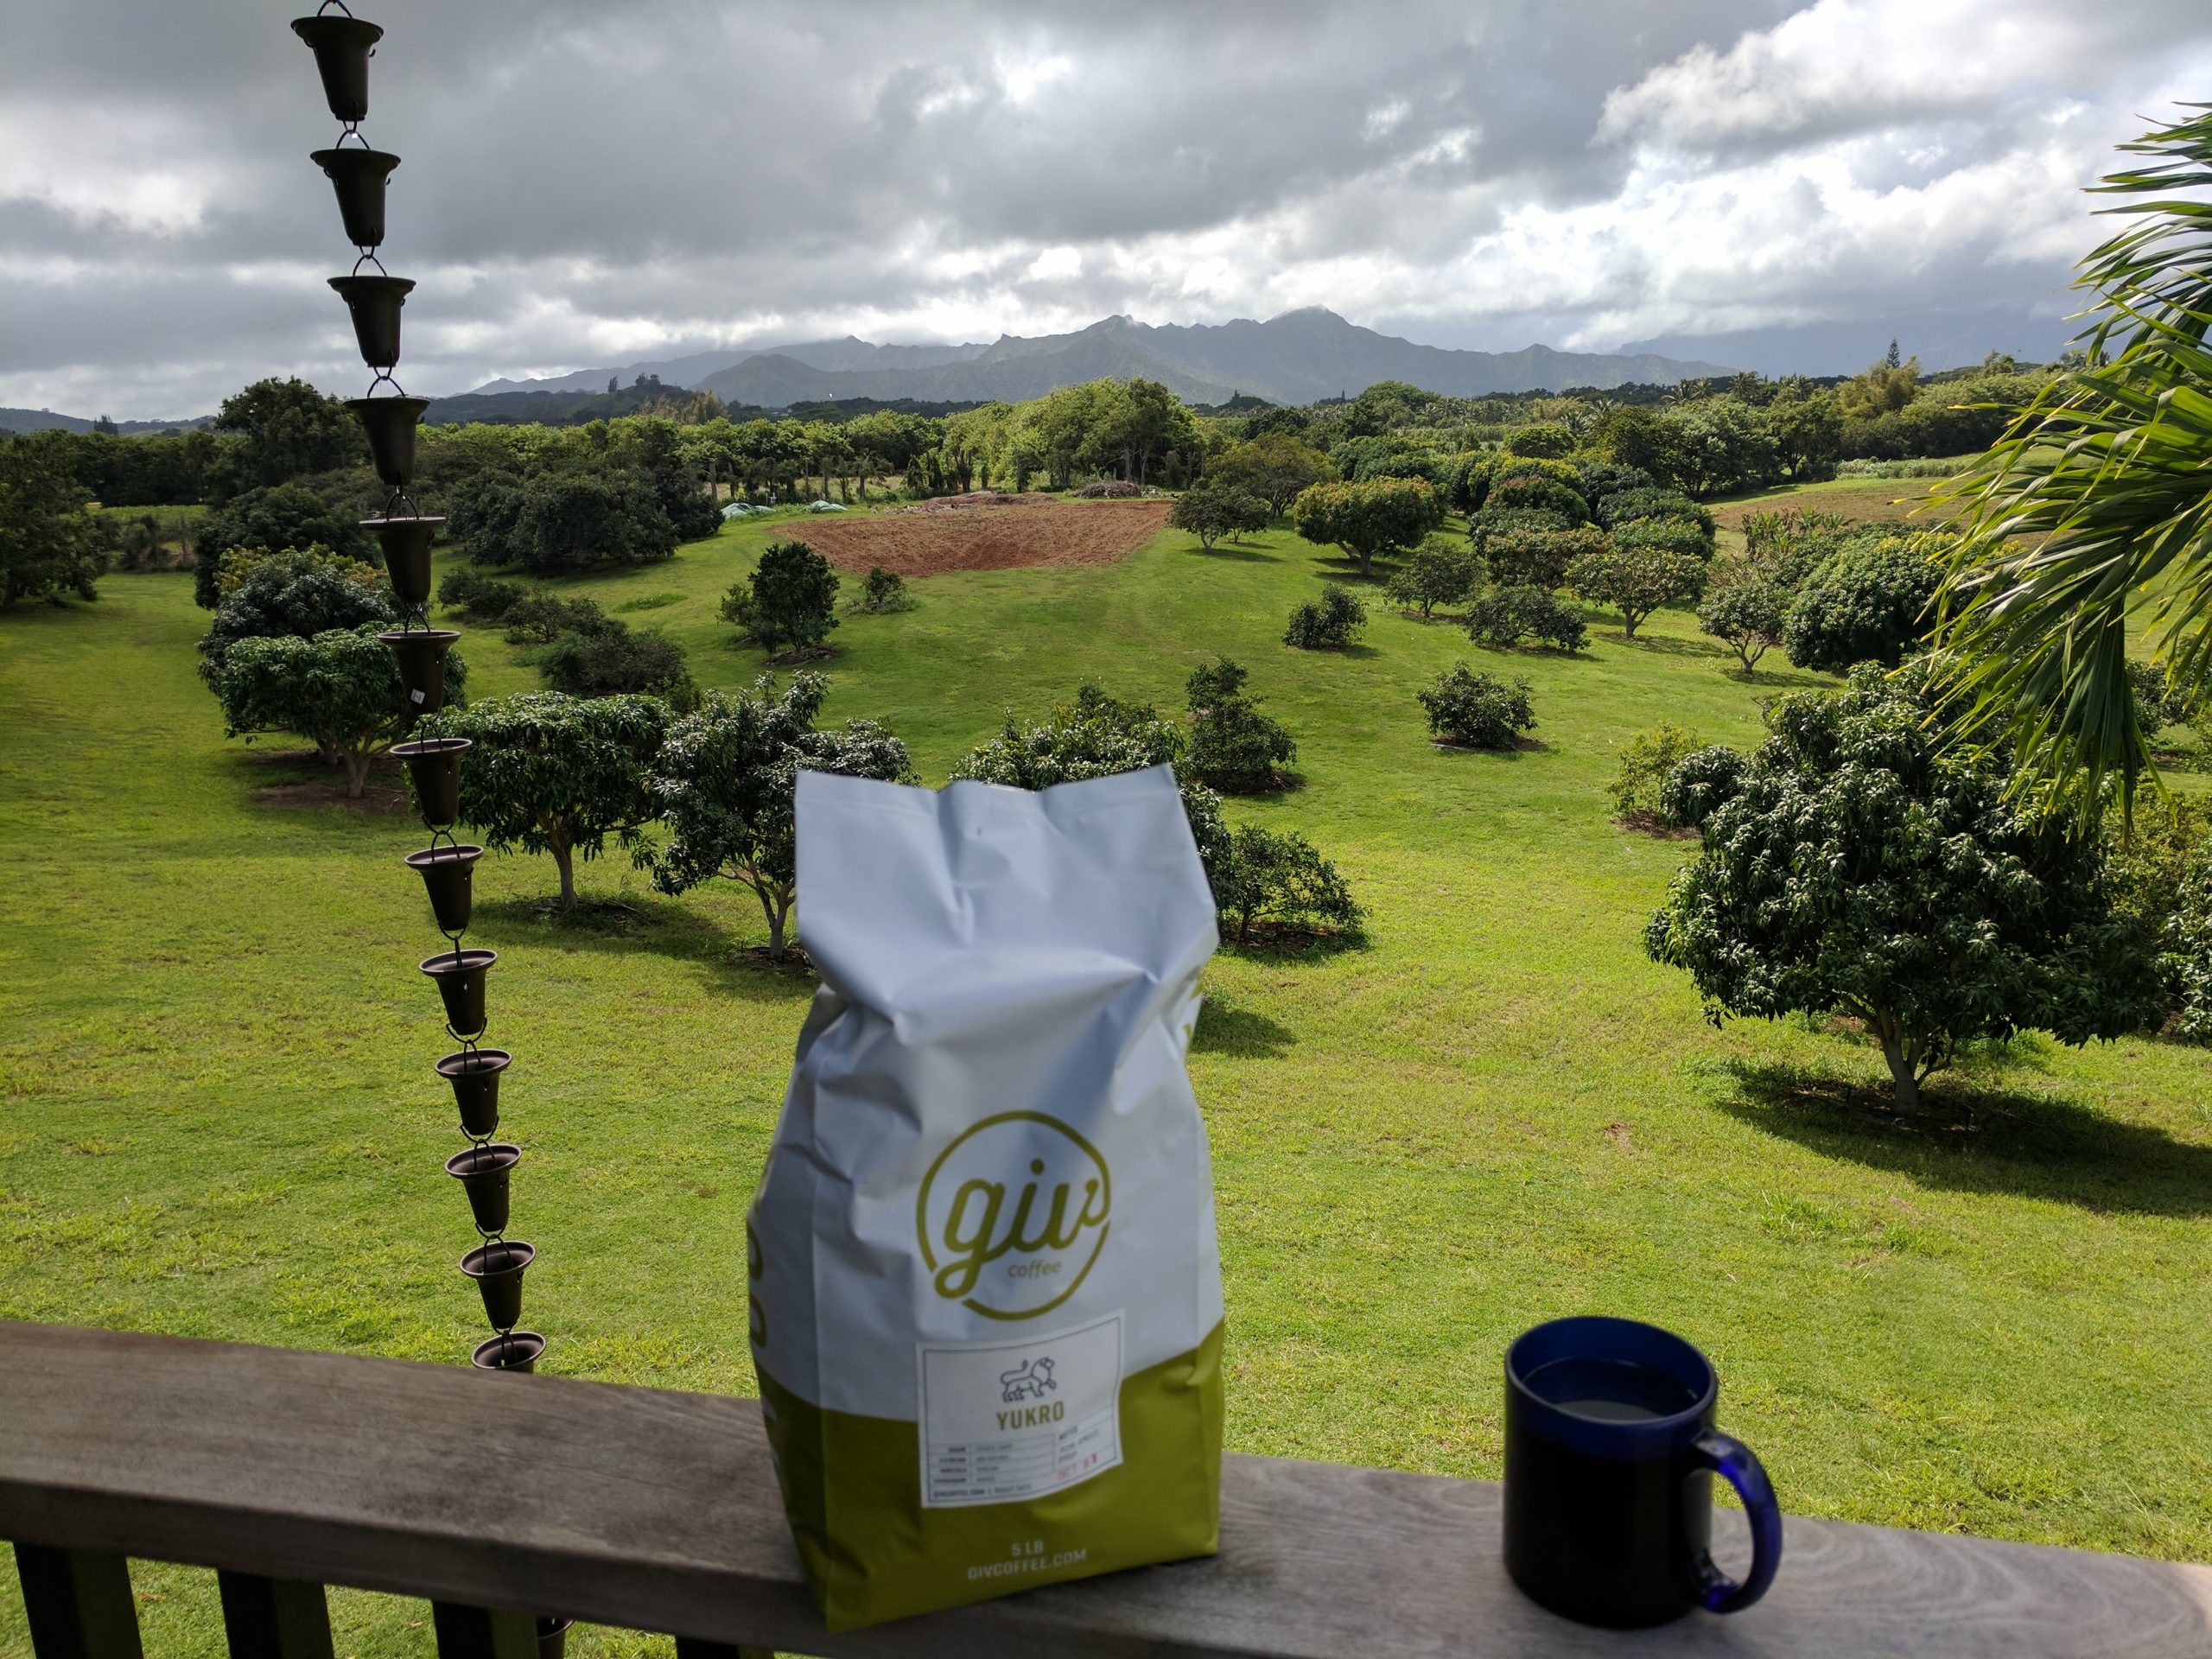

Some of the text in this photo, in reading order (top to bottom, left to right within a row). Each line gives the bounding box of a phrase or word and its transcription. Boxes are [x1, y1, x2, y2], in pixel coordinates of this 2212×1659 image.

[934, 1158, 1110, 1299] giv
[1007, 1259, 1063, 1281] coffee
[996, 1401, 1065, 1431] YUKRO
[1011, 1540, 1045, 1556] 5 LB
[967, 1548, 1087, 1580] GIVCOFFEE.COM
